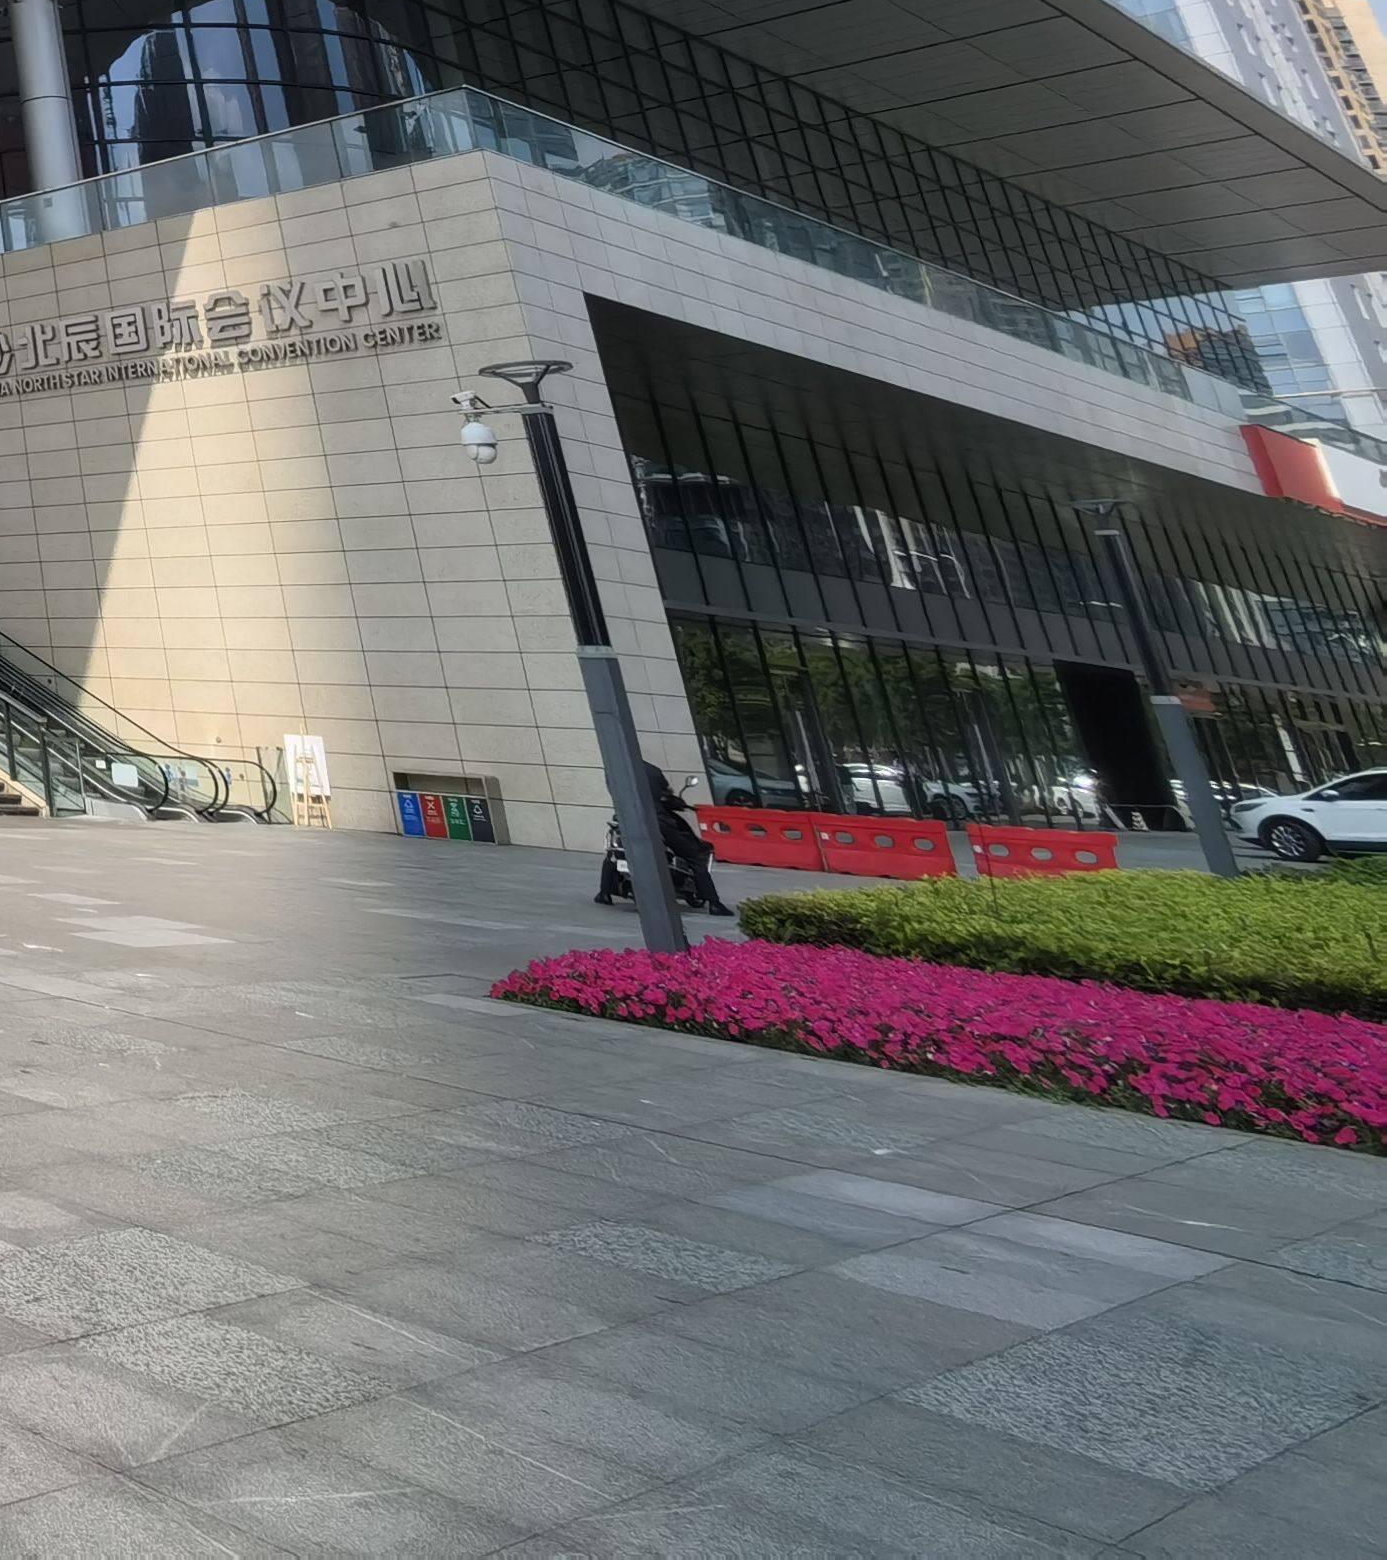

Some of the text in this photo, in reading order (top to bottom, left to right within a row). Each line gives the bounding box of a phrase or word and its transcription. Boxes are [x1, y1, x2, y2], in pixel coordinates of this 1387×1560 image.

[104, 351, 235, 382] INTERNATIONAL
[237, 332, 357, 364] CONVENTION
[363, 322, 443, 348] CENTER
